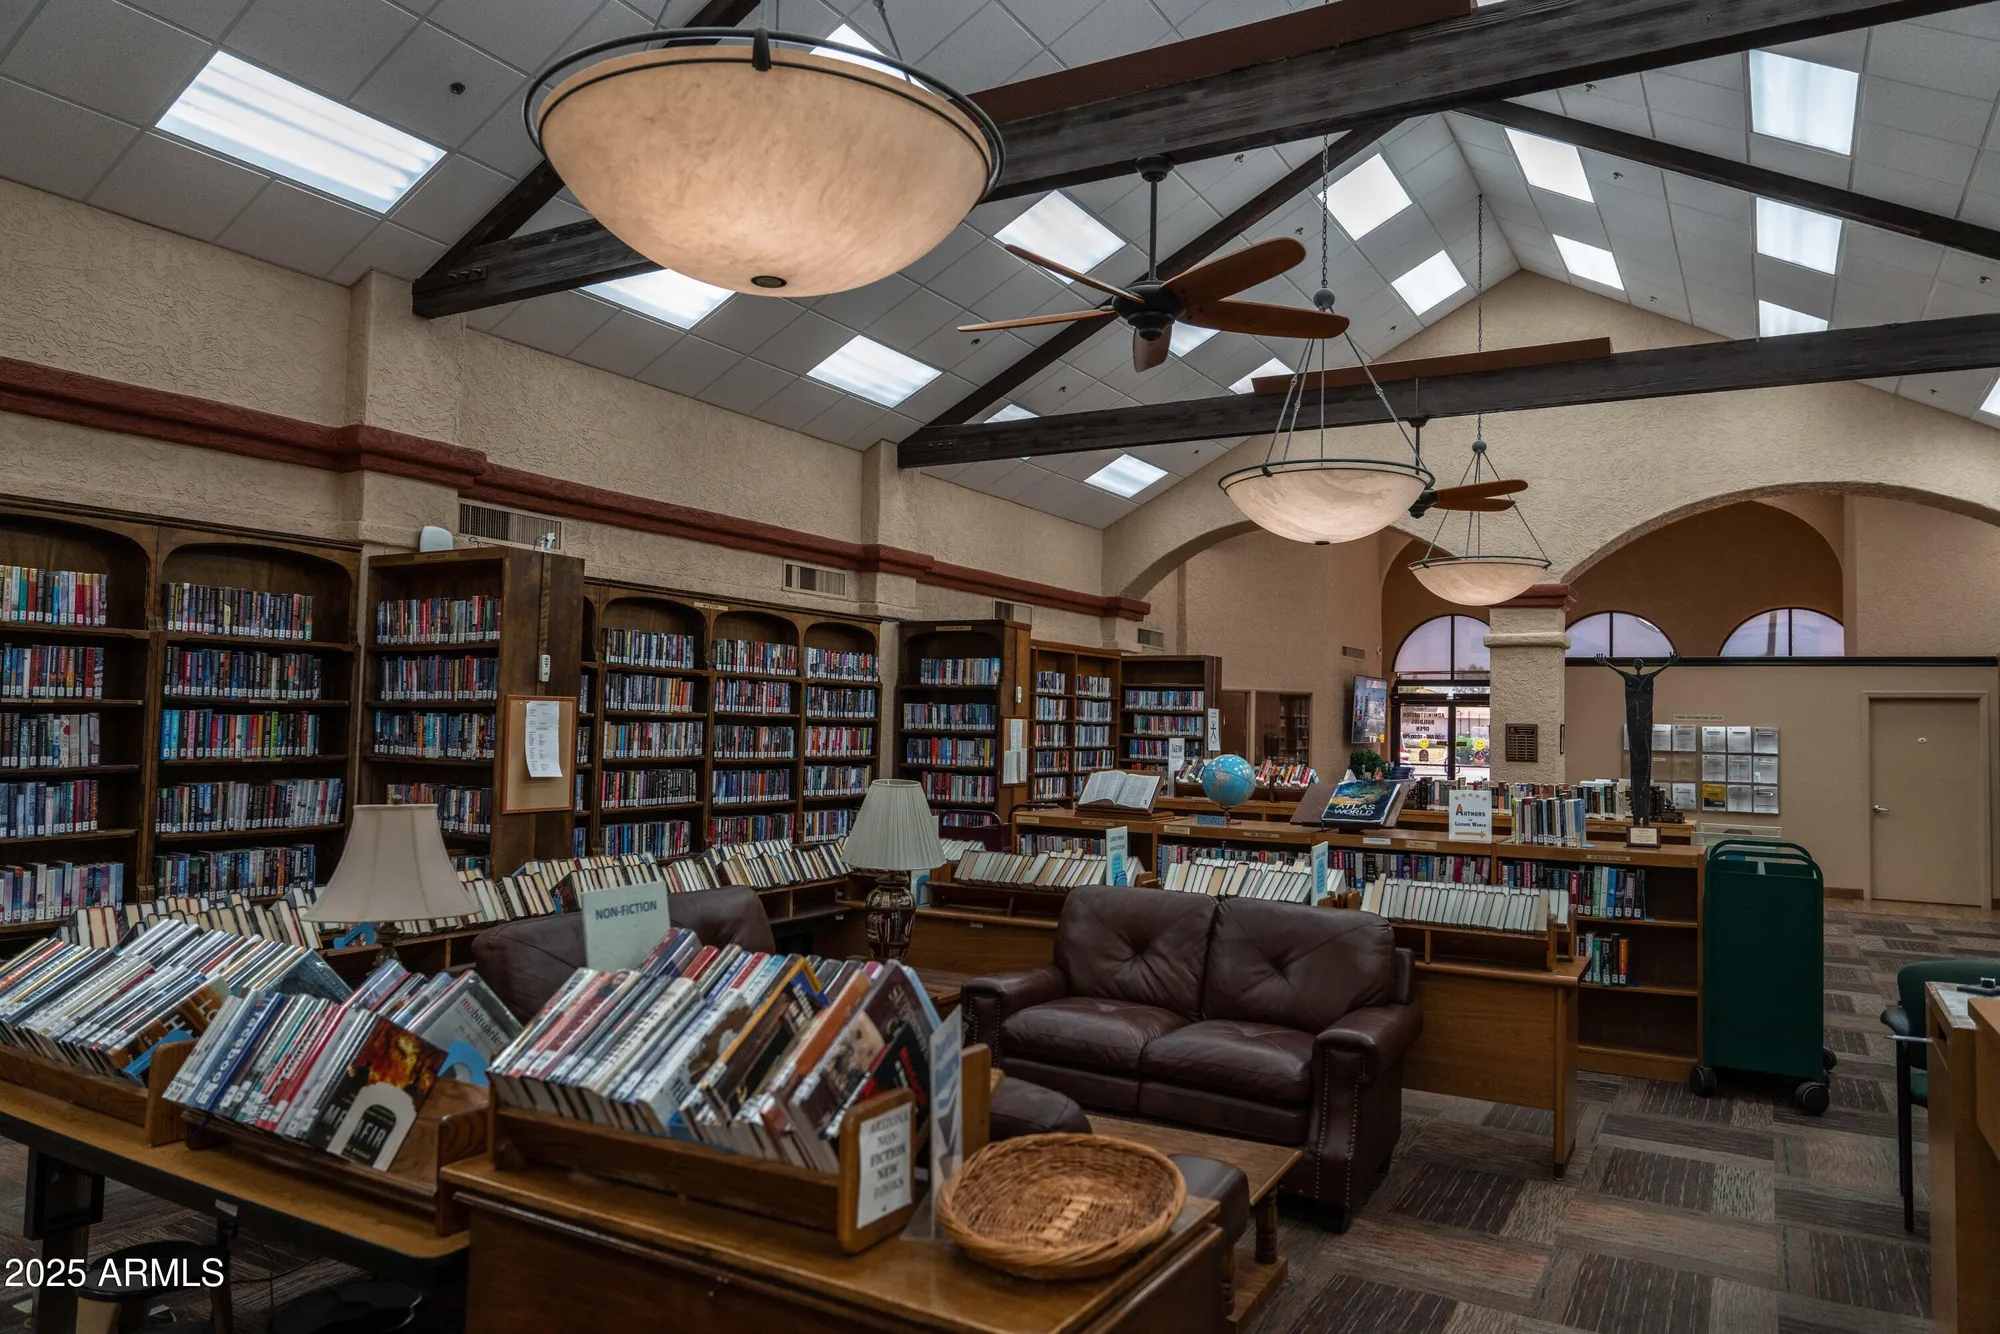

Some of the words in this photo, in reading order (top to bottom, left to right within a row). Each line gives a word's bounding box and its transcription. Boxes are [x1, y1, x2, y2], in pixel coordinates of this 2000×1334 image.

[595, 900, 657, 920] NON-FICTION
[204, 1006, 266, 1090] faceboo
[870, 1142, 907, 1168] FICTION
